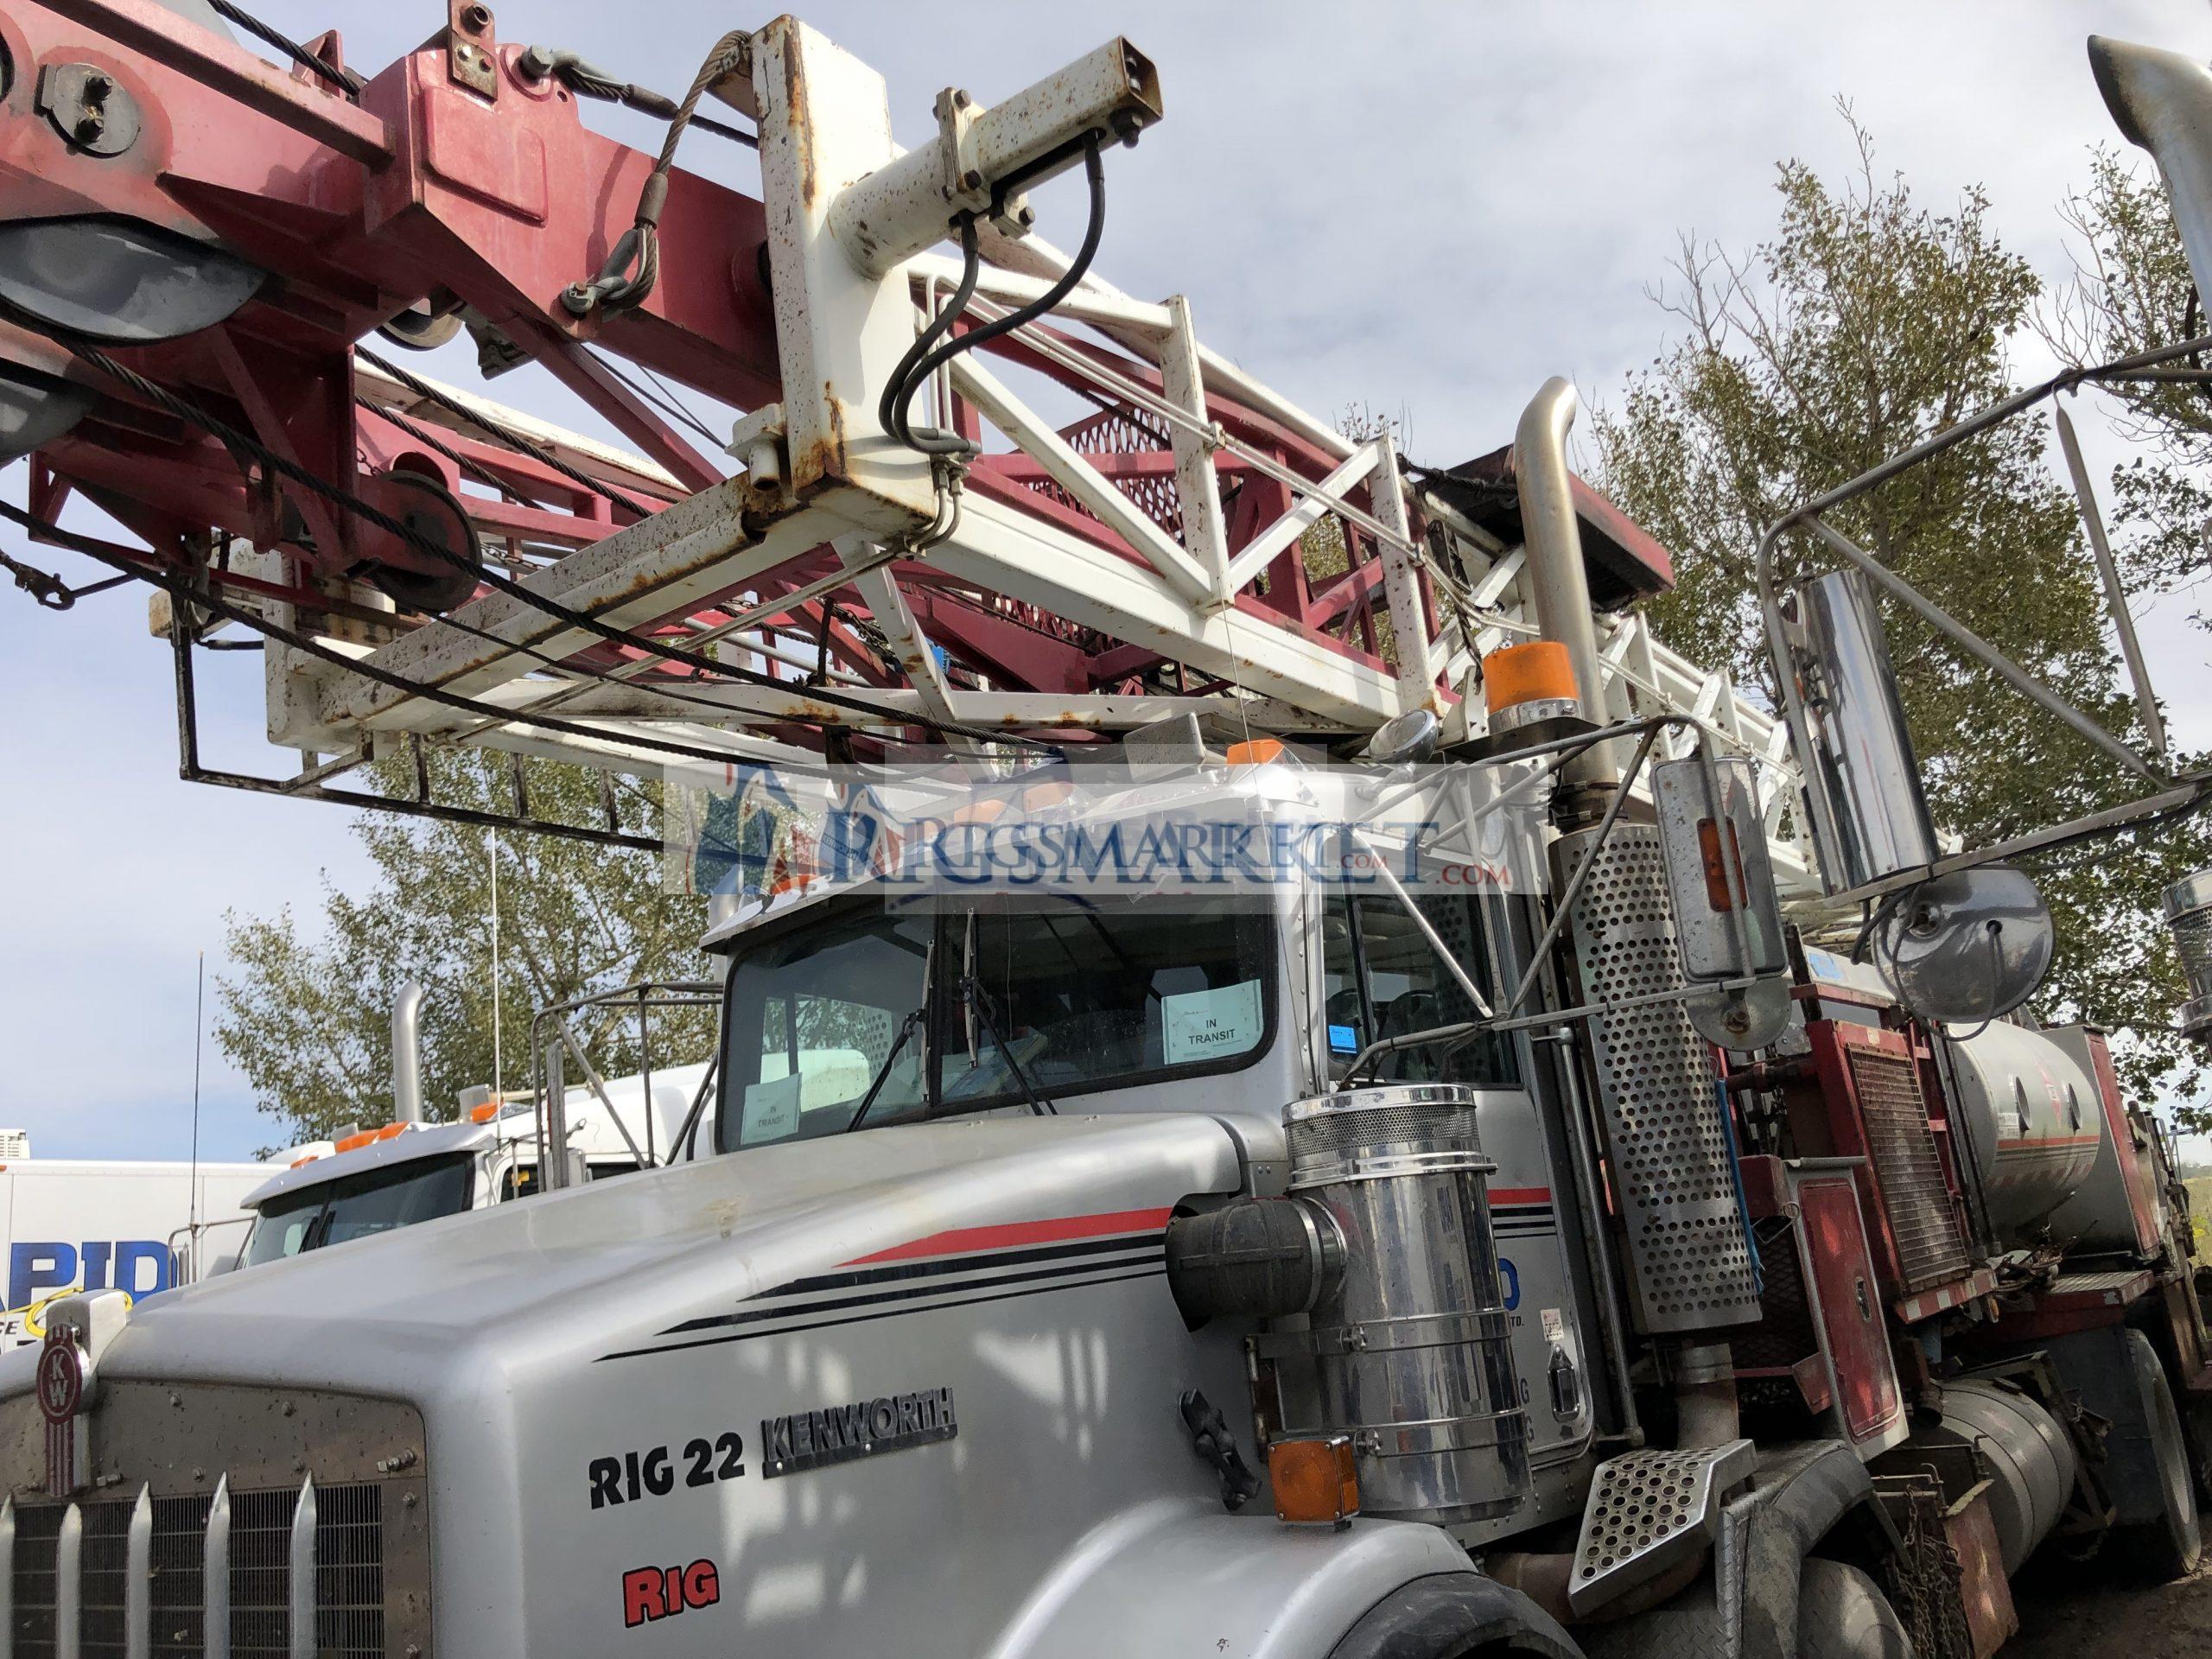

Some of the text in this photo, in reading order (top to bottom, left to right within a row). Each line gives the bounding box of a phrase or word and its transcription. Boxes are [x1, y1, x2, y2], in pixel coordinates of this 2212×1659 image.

[1188, 1028, 1236, 1045] TRANSIT
[1206, 1019, 1217, 1029] IN
[0, 1241, 178, 1311] PID
[760, 1387, 957, 1463] KENWORTH
[588, 1432, 746, 1510] RIG 22
[622, 1558, 721, 1628] RIG
